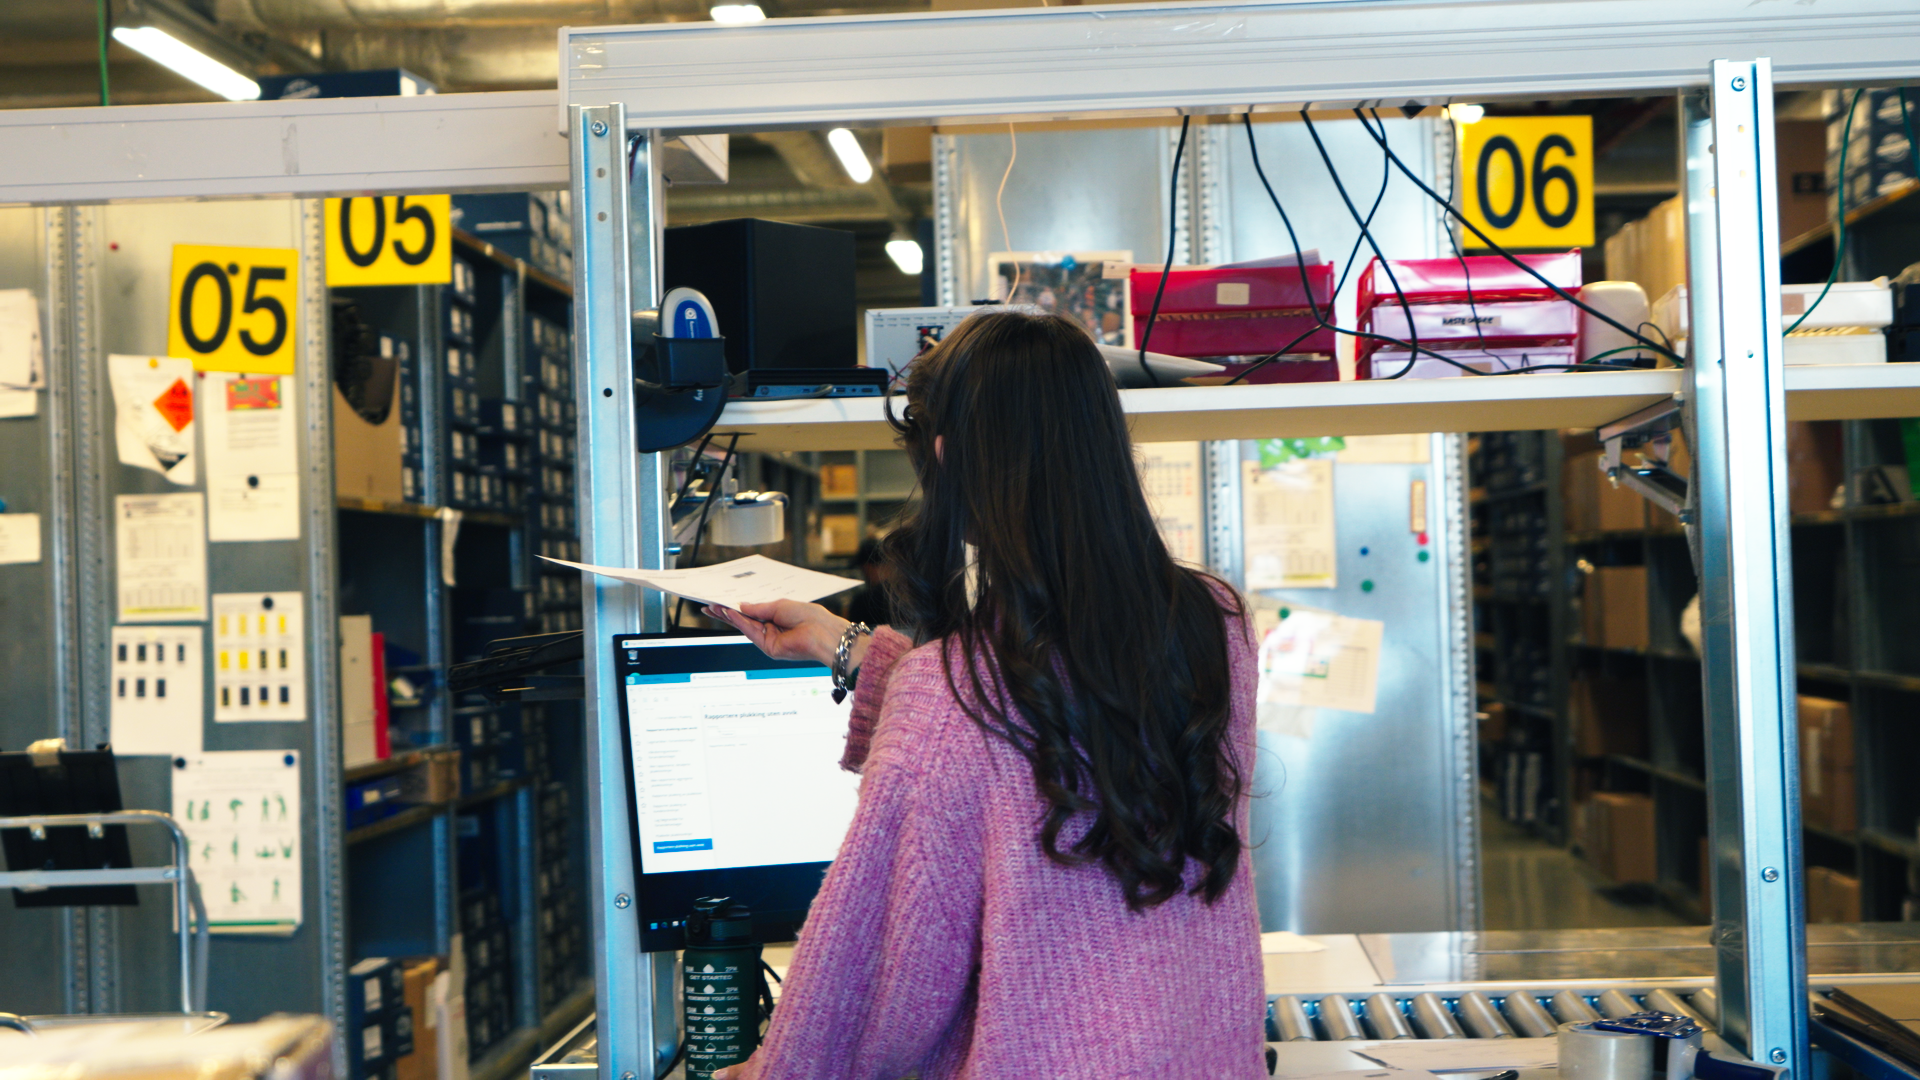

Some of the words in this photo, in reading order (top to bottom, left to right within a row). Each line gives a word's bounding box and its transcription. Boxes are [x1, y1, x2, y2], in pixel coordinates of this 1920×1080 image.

[1476, 134, 1578, 229] 06
[340, 196, 436, 267] 05
[179, 261, 288, 356] 05
